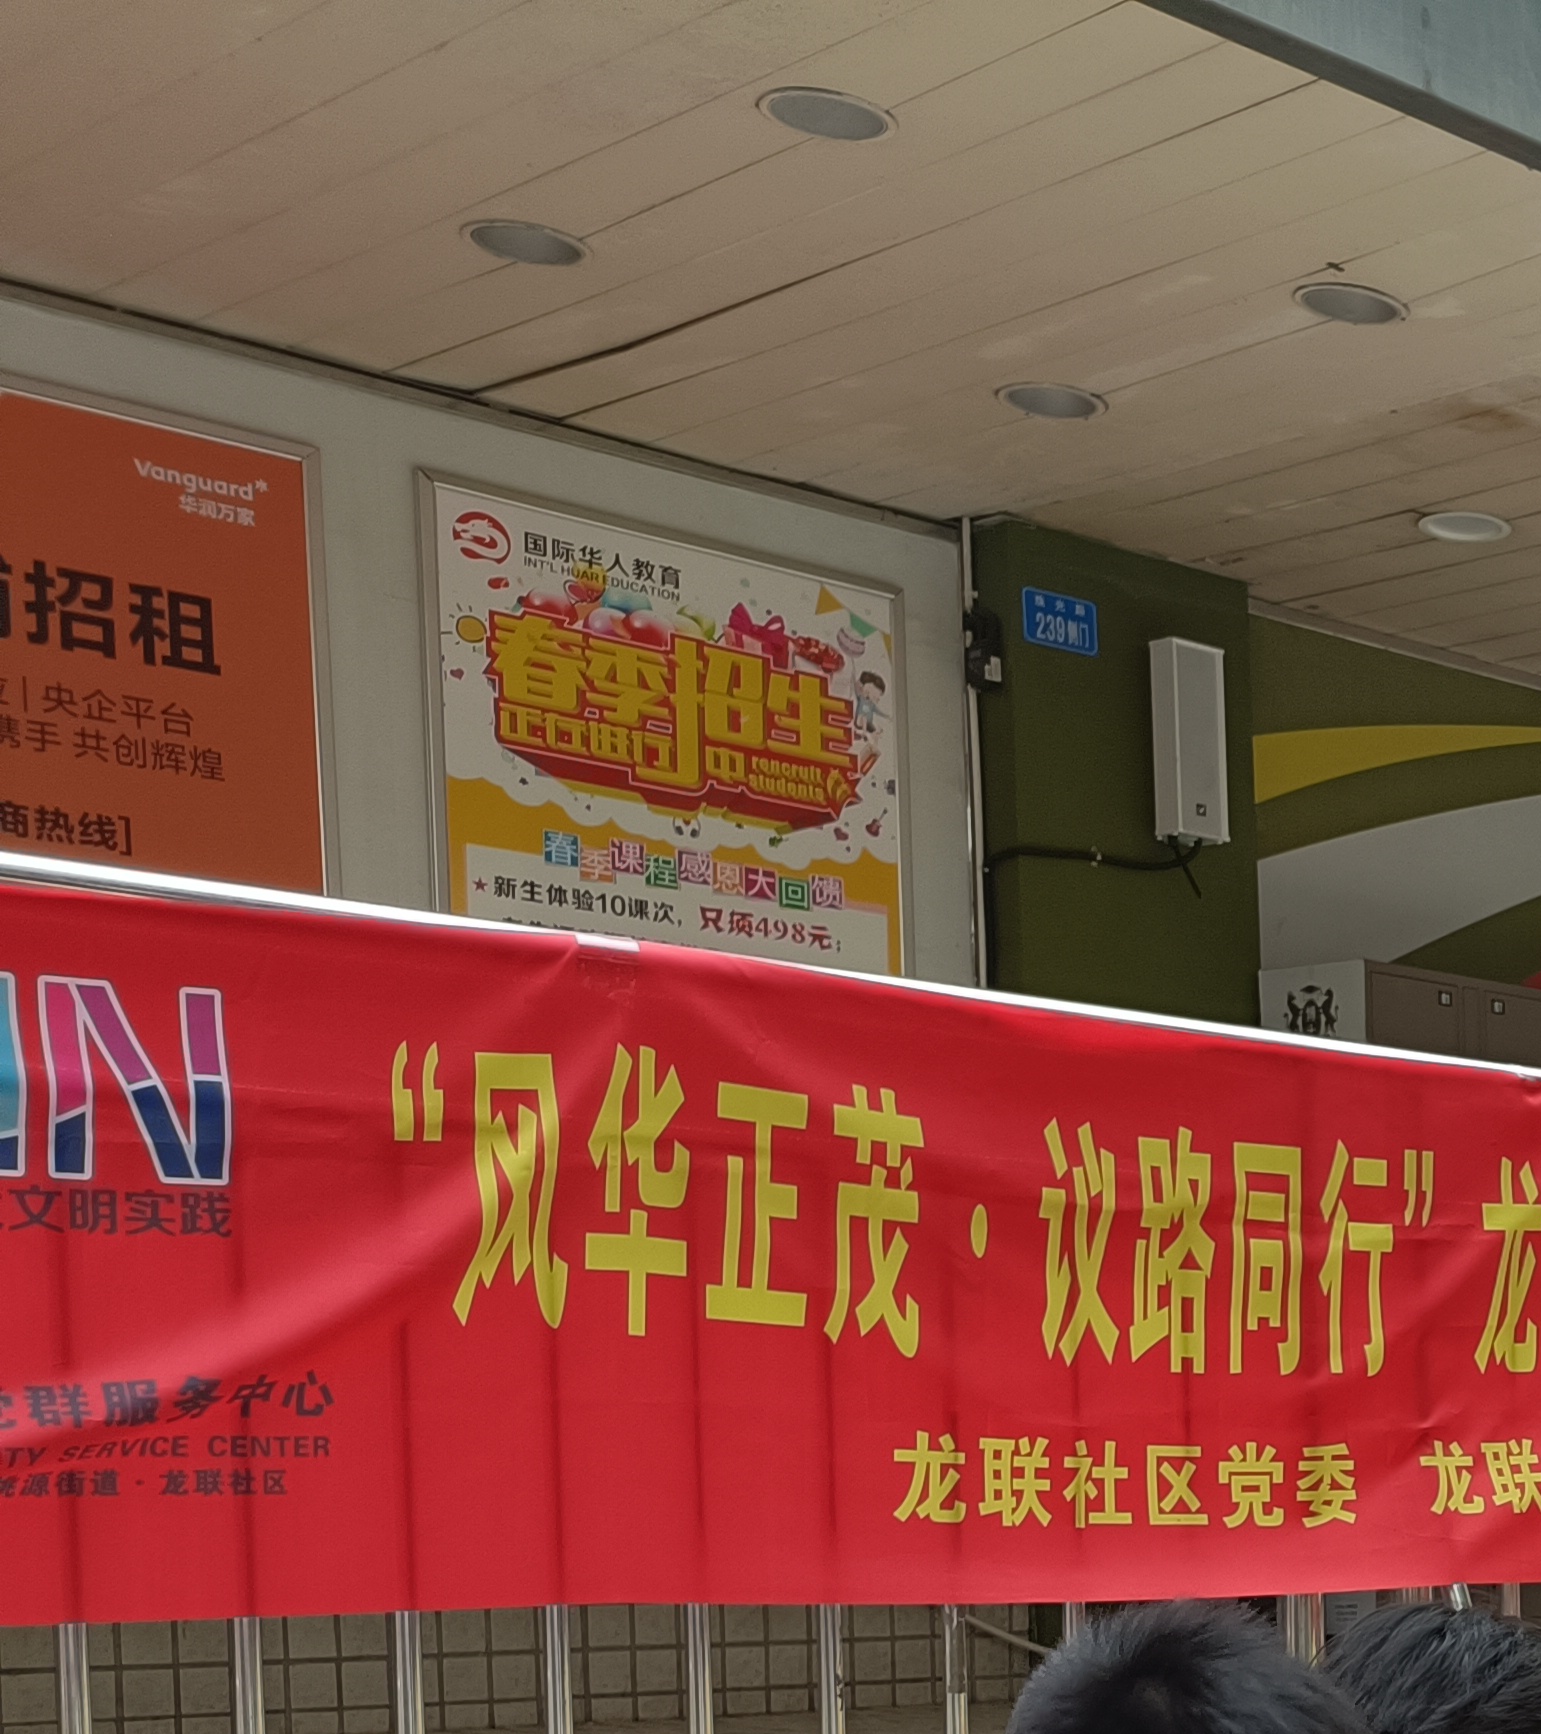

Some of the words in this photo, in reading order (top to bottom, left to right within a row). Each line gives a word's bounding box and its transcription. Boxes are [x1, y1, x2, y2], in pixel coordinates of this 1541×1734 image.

[133, 457, 255, 502] Vanguard
[179, 494, 256, 527] 华润万家
[523, 531, 682, 590] 国际华人教育
[523, 554, 557, 575] INT'L
[603, 574, 681, 603] EDUCATION
[492, 612, 854, 786] 春季招生
[73, 725, 226, 783] 共创辉煌
[543, 829, 845, 911] 春季课程感恩大回馈
[0, 1185, 233, 1237] 文明实践
[390, 1040, 1435, 1378] “风华正茂·议路同行”
[58, 1436, 189, 1462] SERVICE
[208, 1436, 330, 1457] CENTER
[893, 1430, 1358, 1529] 龙联社区党委
